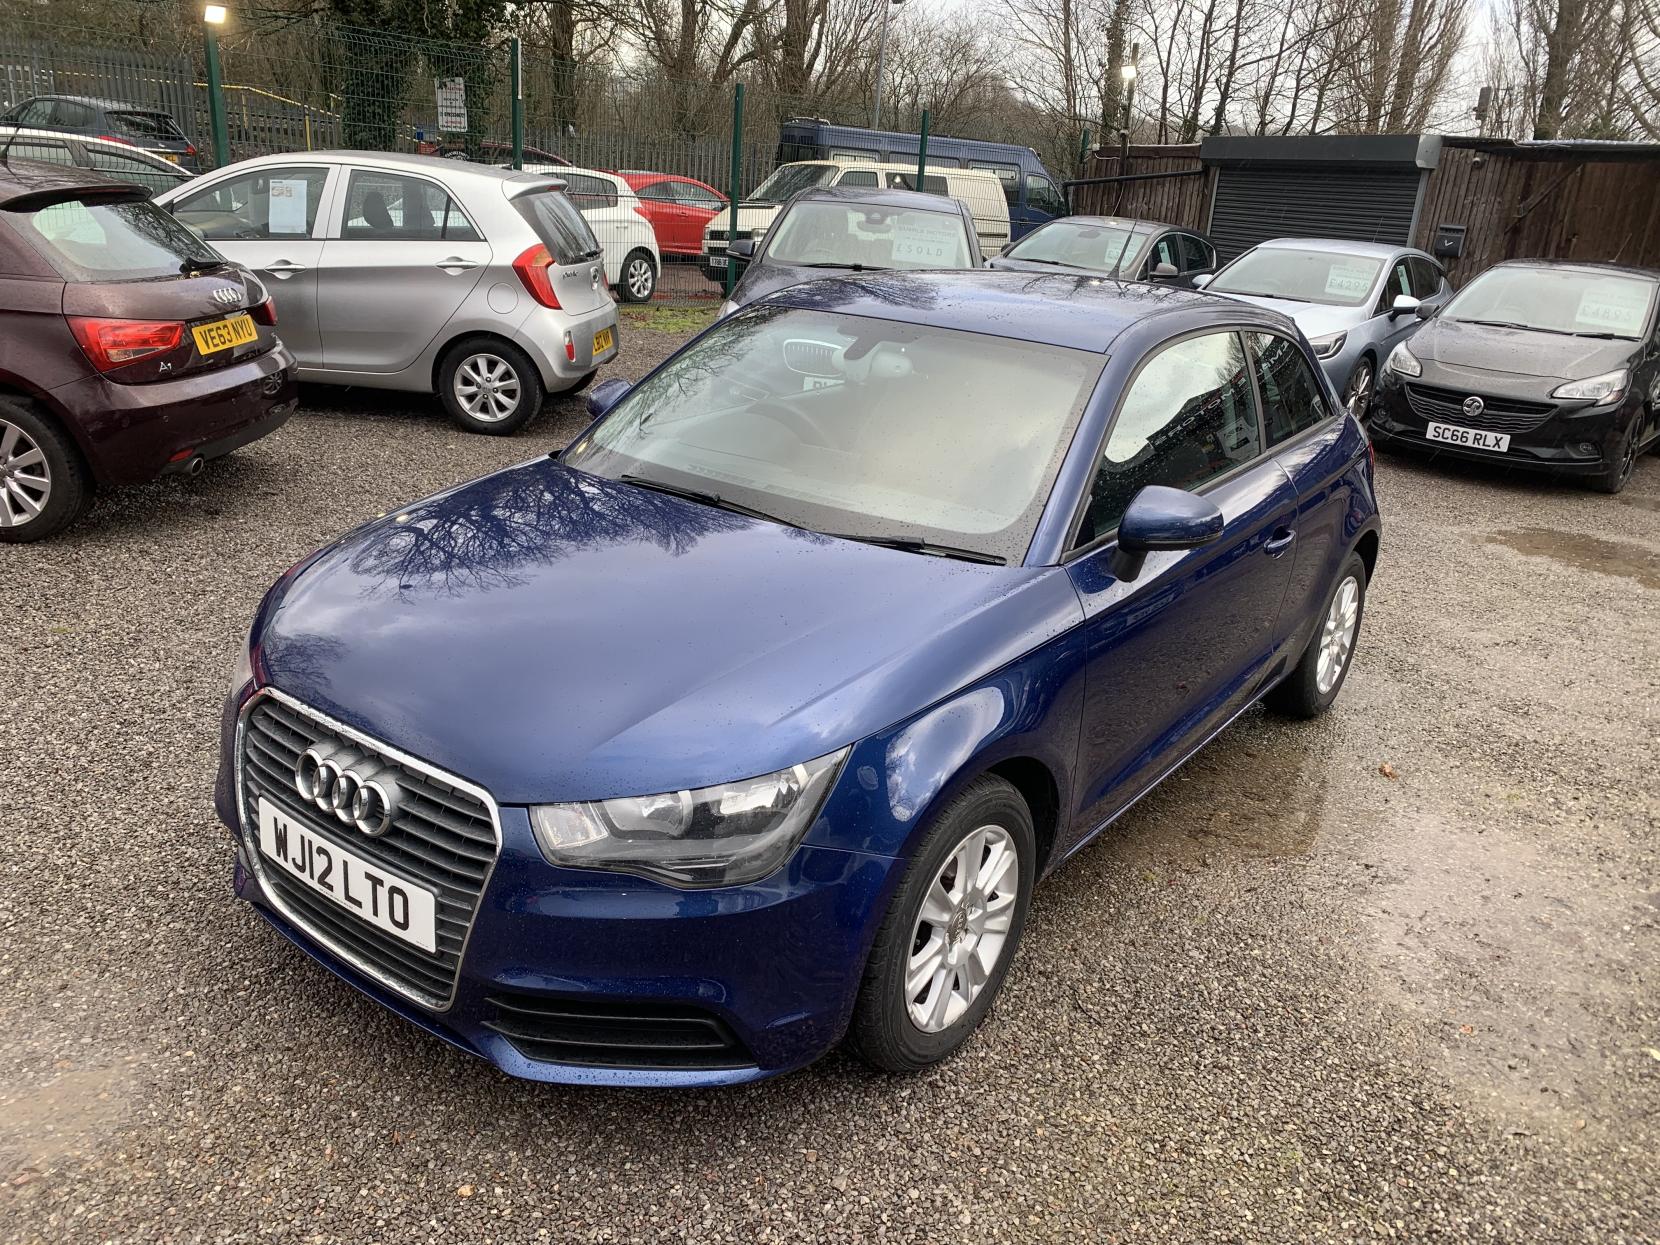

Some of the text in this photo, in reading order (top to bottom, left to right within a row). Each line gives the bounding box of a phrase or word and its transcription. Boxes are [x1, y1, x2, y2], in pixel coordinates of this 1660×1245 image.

[199, 318, 253, 350] VE63 NYU
[159, 361, 172, 373] A1
[1432, 425, 1504, 450] SC66 RLX
[273, 815, 410, 932] WJ12 LTO
